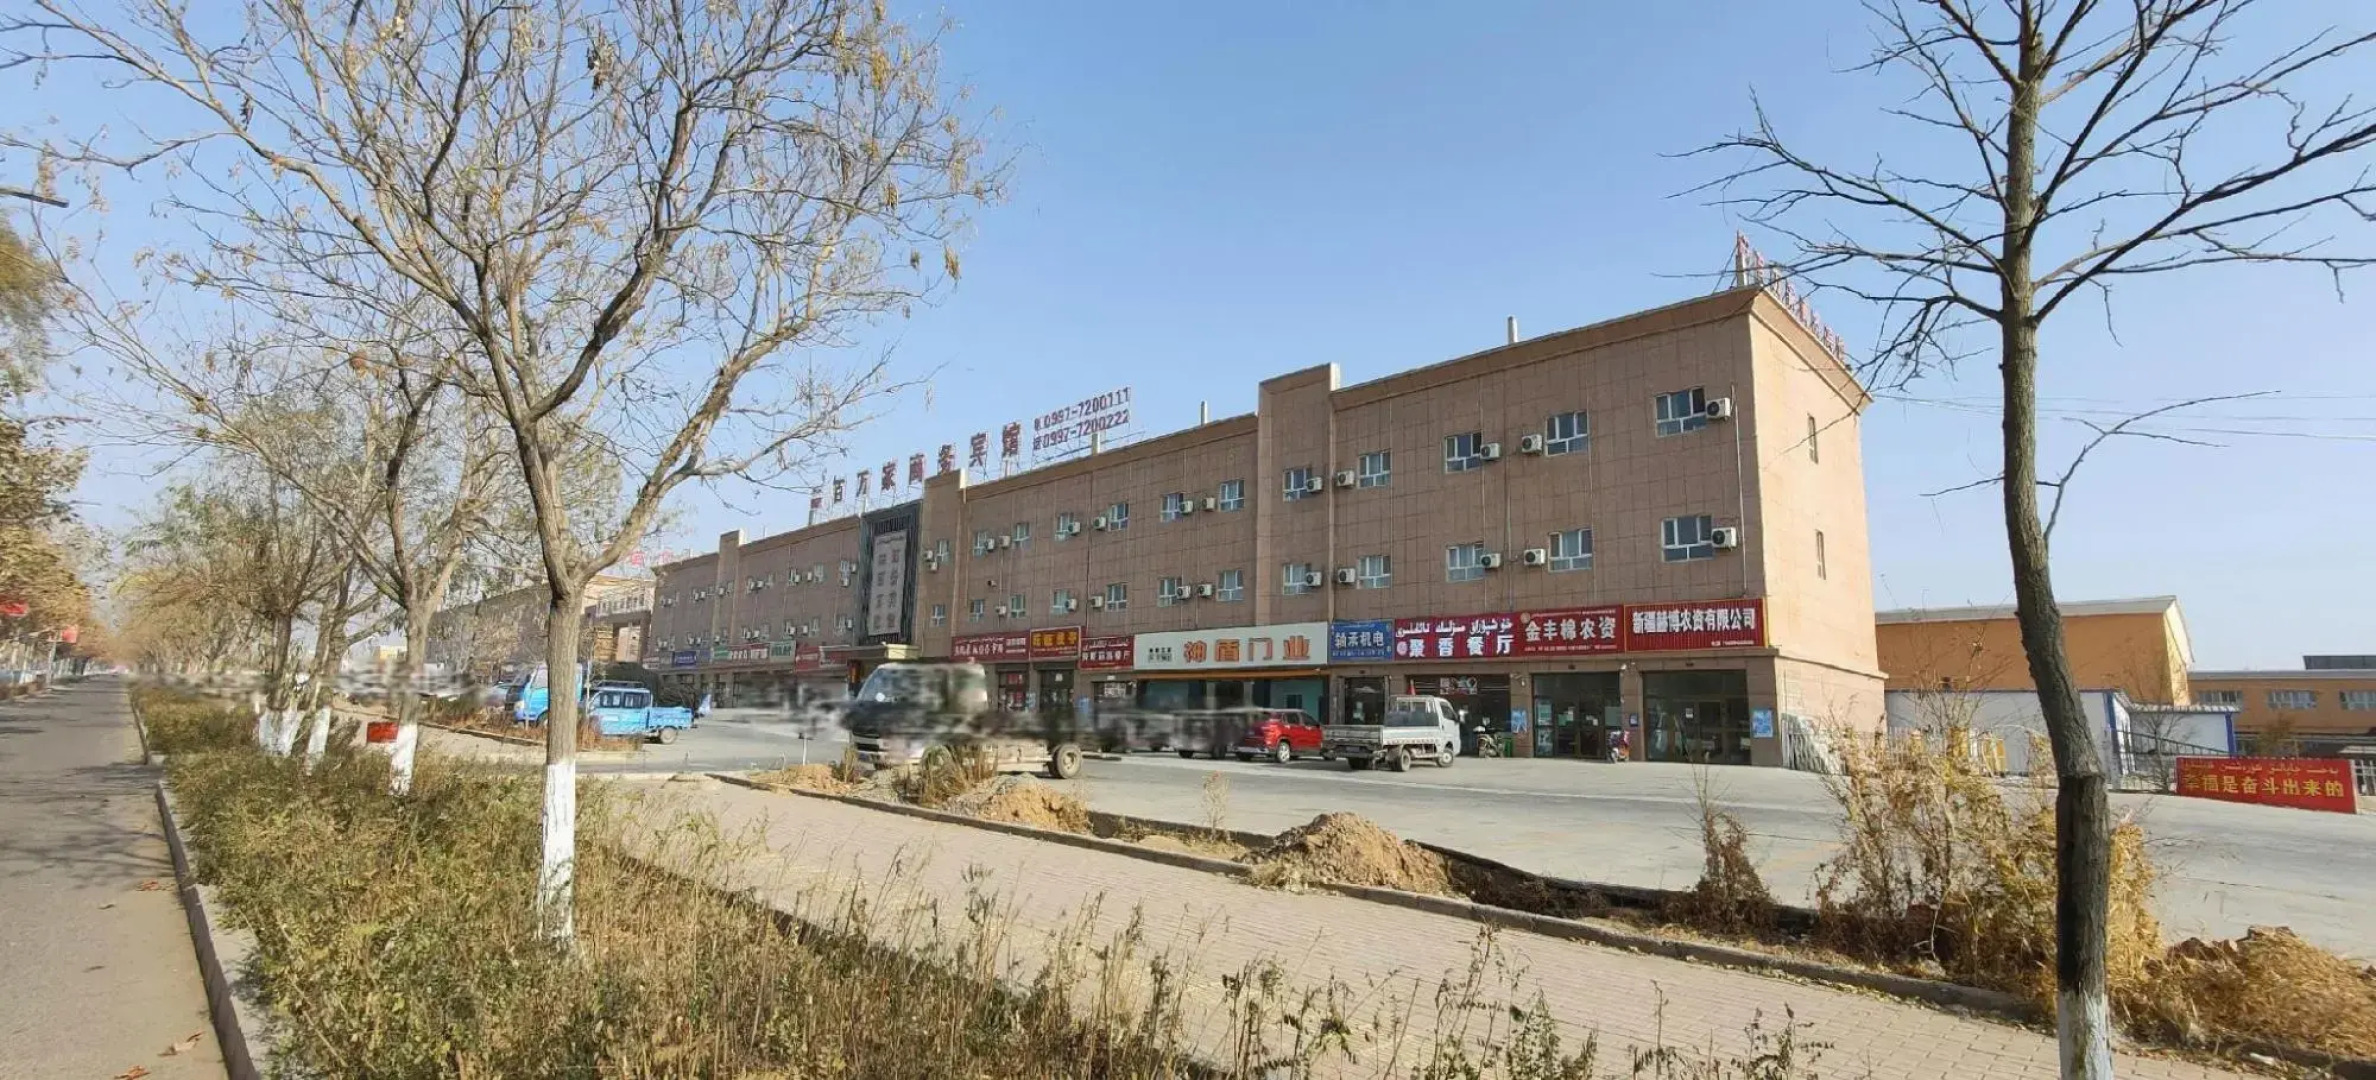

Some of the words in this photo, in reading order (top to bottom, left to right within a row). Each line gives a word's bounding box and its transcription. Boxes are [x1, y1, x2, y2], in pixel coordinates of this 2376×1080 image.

[1524, 616, 1617, 642] 金丰棉农资
[1183, 635, 1311, 663] 神盾门业
[1409, 634, 1515, 657] 聚香餐厅
[2184, 774, 2345, 798] 幸福是奋斗出来的
